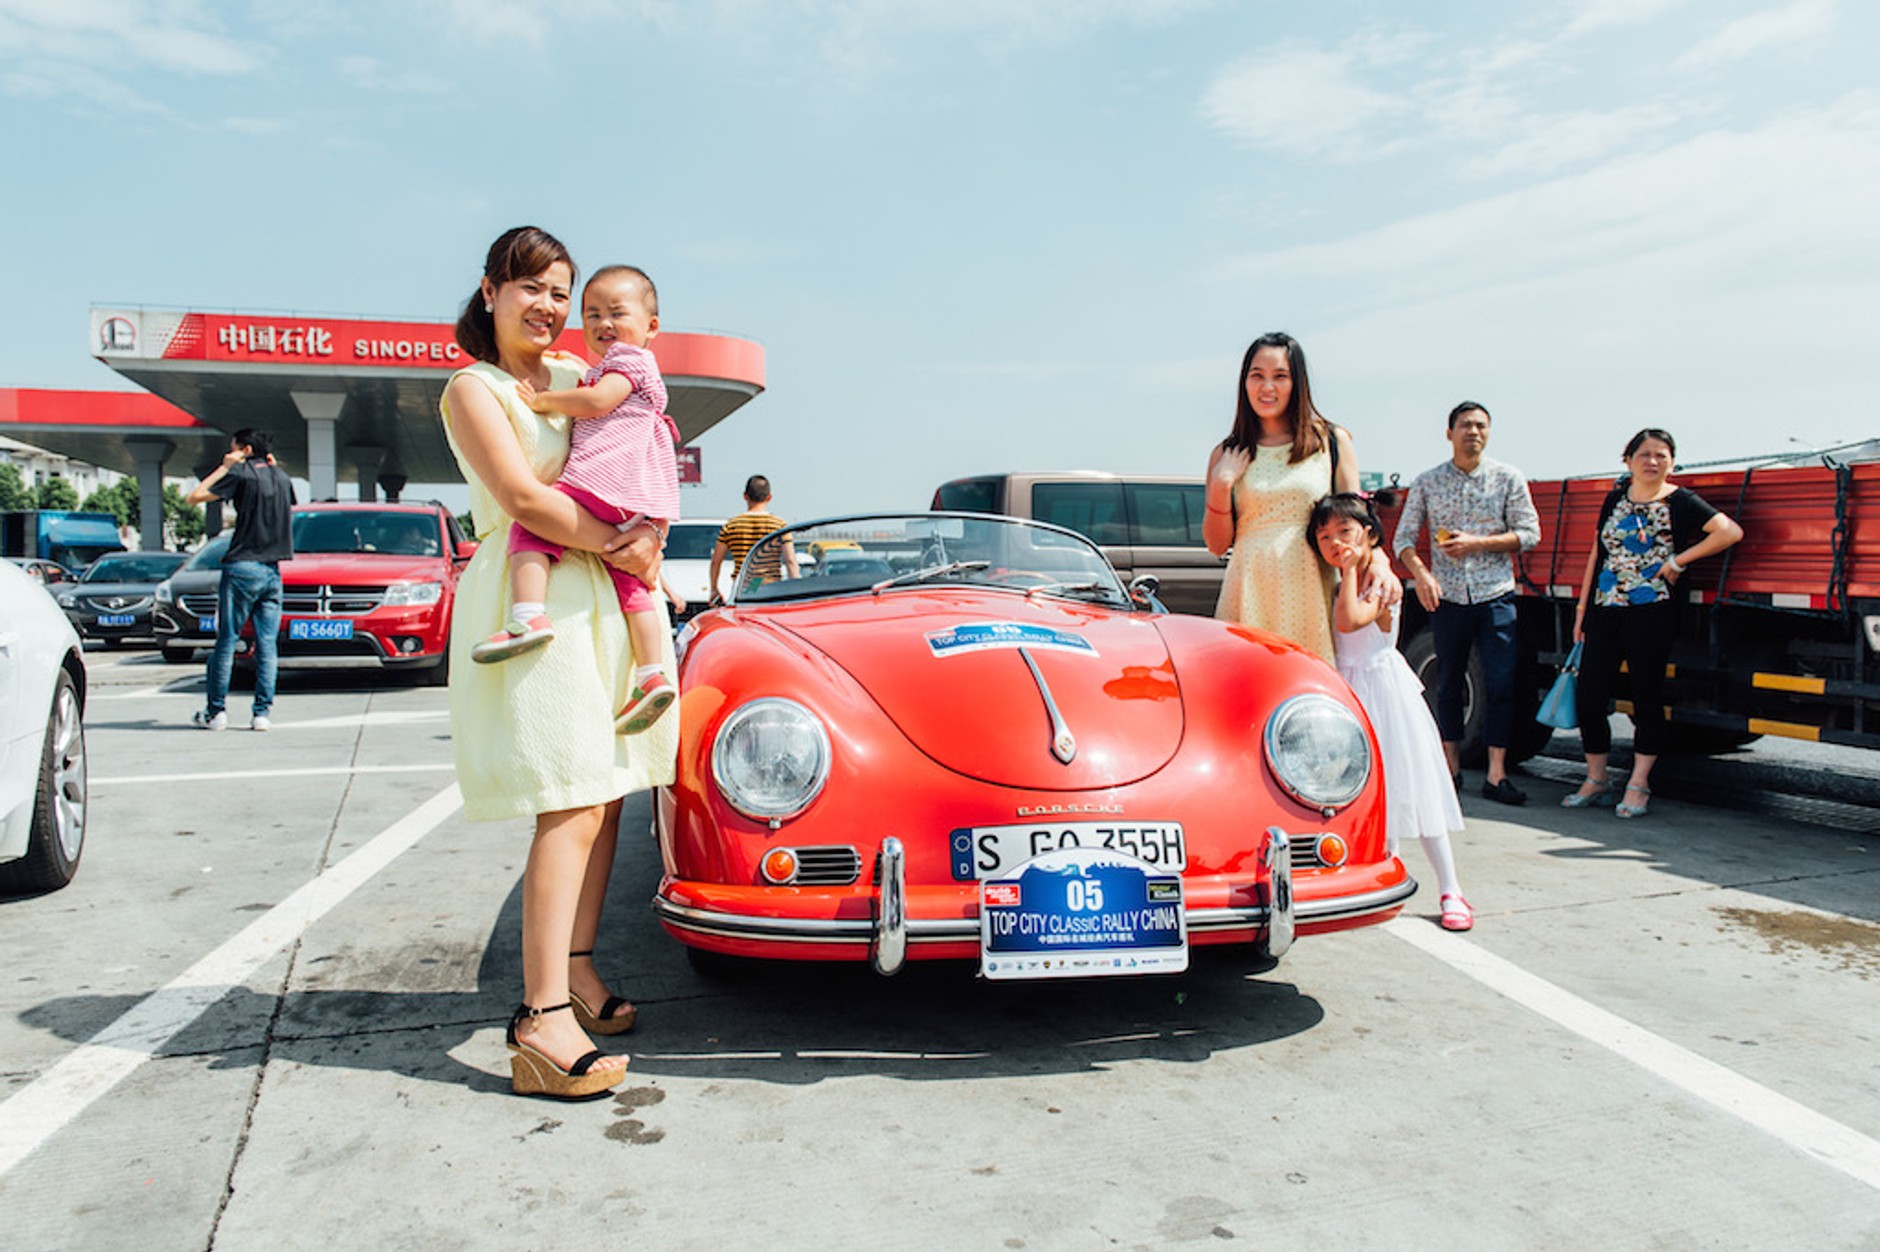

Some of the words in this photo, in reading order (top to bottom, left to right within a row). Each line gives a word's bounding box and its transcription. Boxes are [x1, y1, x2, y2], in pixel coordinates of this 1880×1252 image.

[218, 324, 334, 355] 中国石化
[355, 339, 460, 360] SINOPEC
[935, 635, 955, 646] TOP
[1017, 804, 1124, 817] PORSCHE
[977, 834, 1001, 871] S
[1096, 829, 1183, 865] 355H
[960, 863, 969, 875] D
[1066, 880, 1104, 912] 05
[991, 912, 1019, 935] TOP
[1020, 912, 1048, 934] CITY
[1051, 914, 1100, 933] CLASSIC
[1102, 910, 1141, 932] RALLY
[1142, 907, 1178, 931] CHINA
